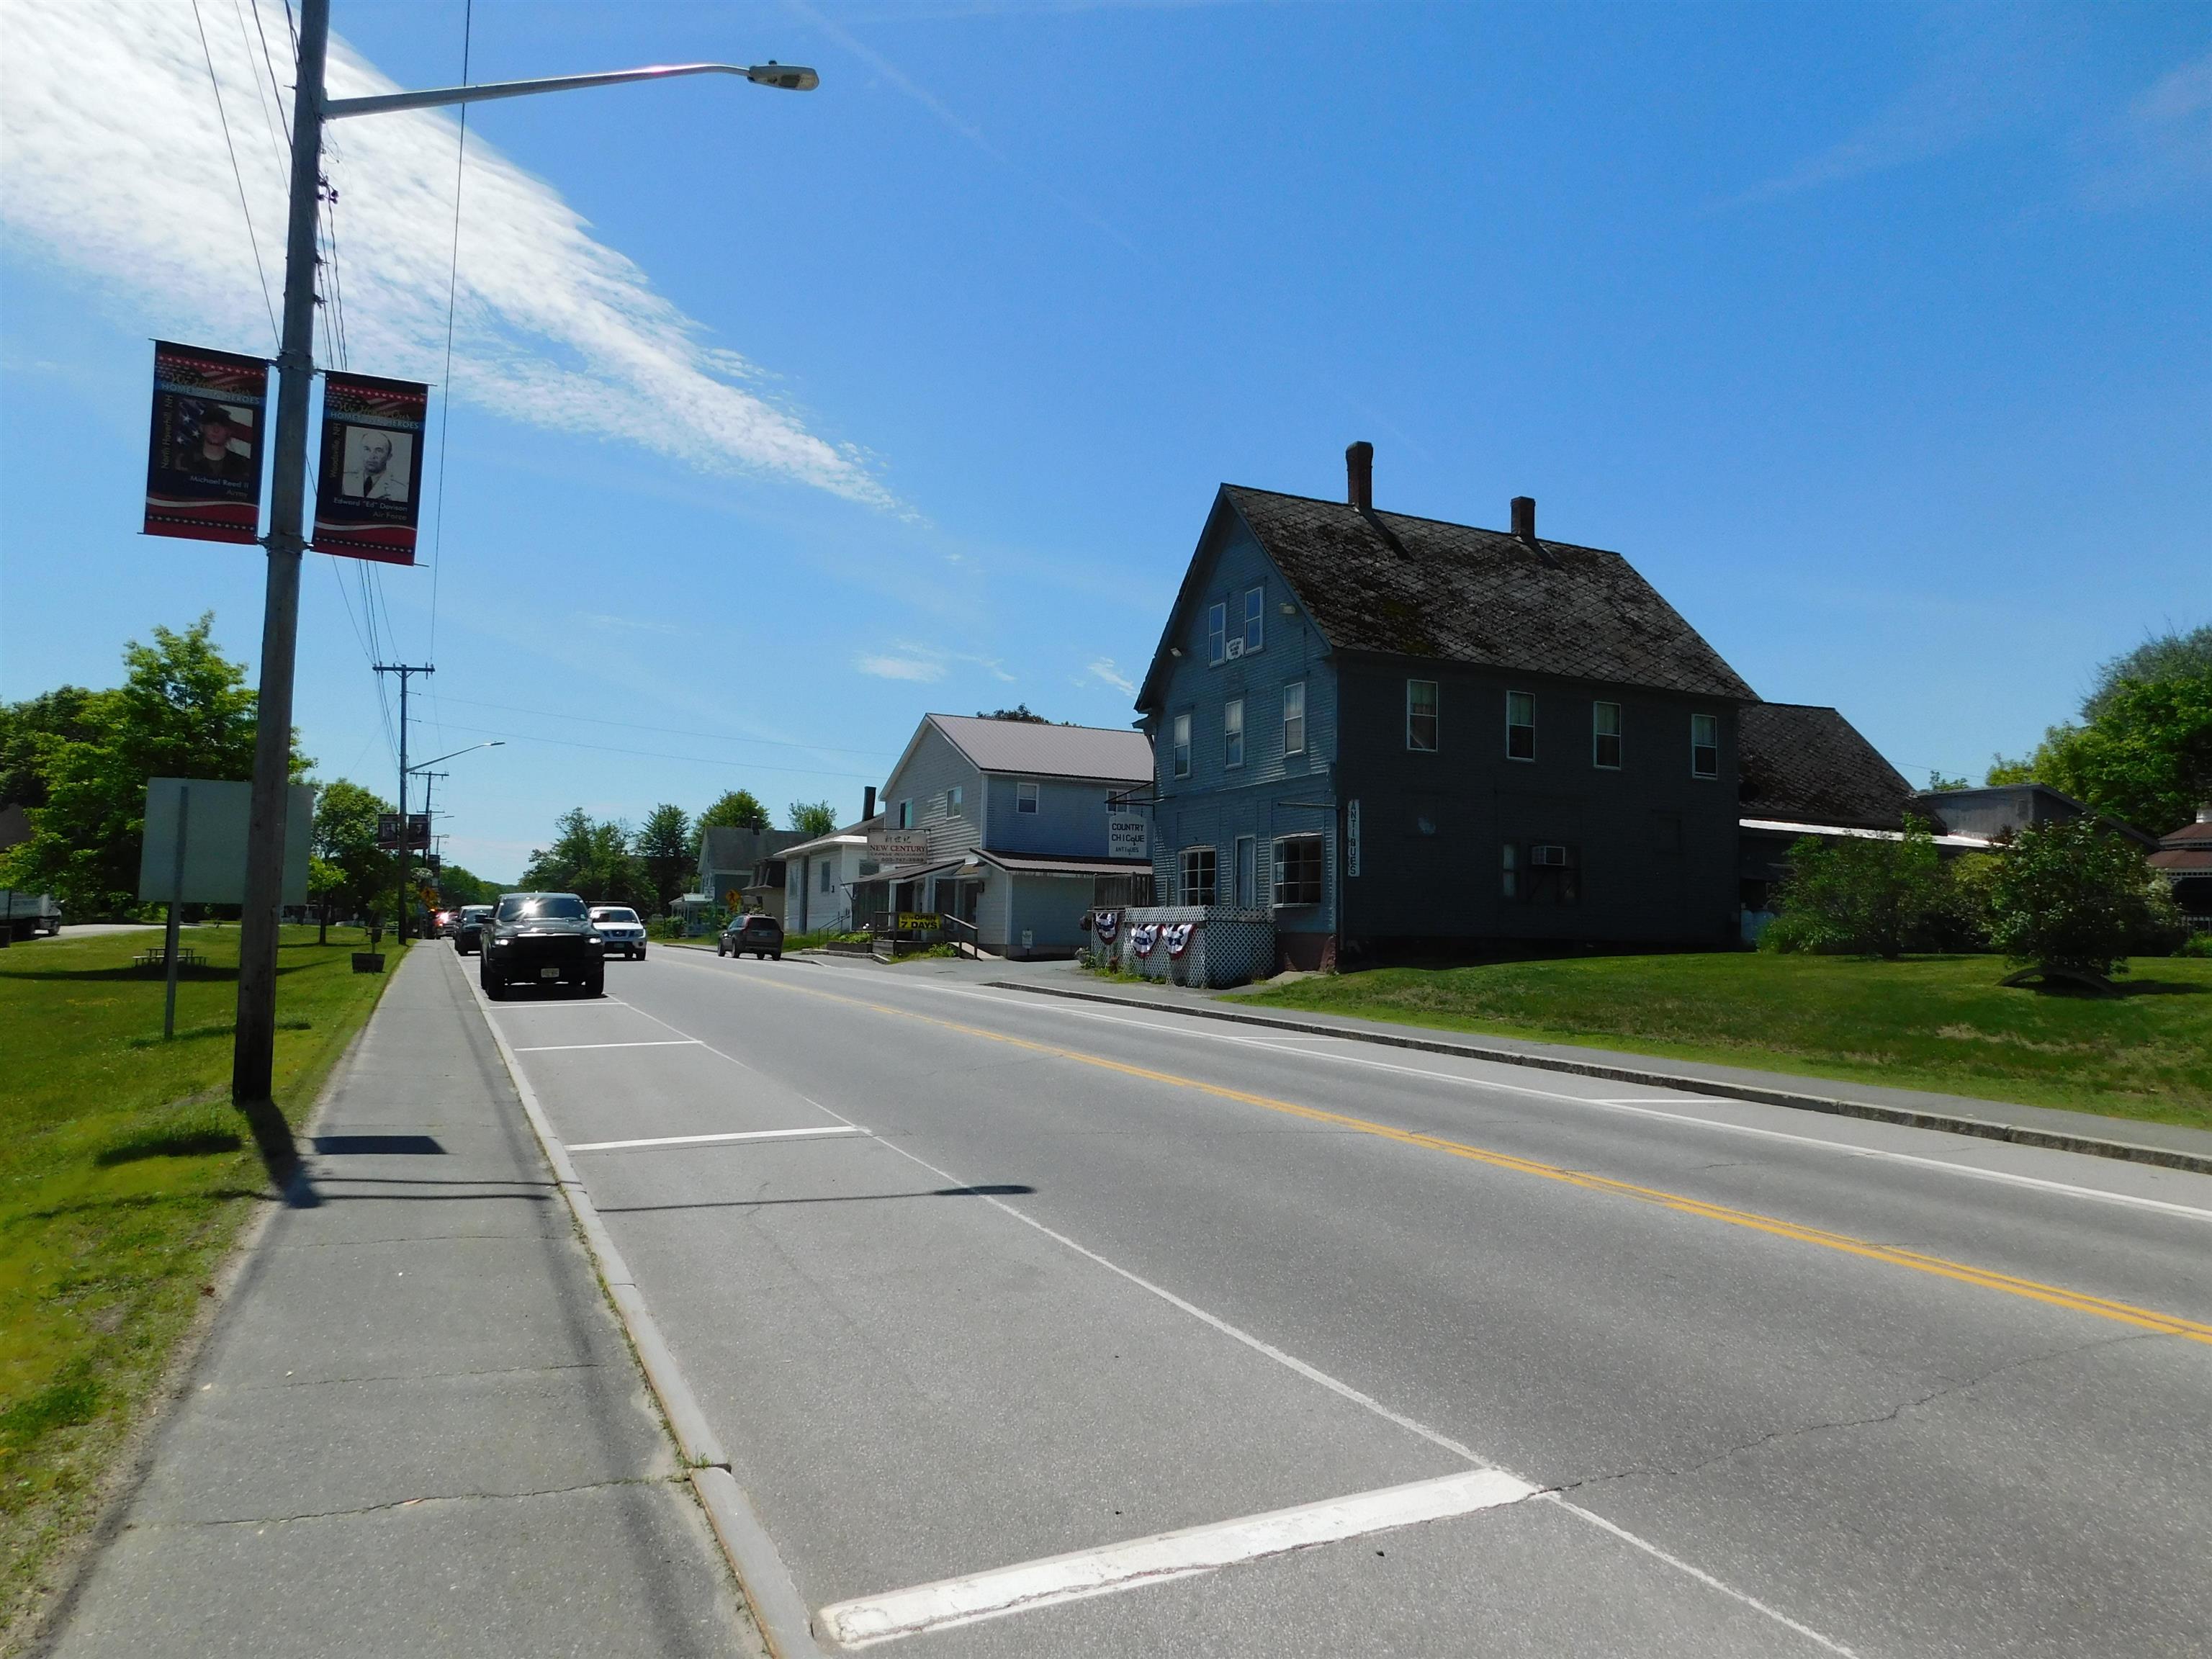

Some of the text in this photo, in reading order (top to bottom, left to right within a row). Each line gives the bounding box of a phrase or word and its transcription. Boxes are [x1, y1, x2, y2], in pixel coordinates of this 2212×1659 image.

[332, 422, 341, 436] NH
[189, 475, 220, 485] Michael
[222, 479, 242, 487] Reed
[333, 497, 361, 507] Edward
